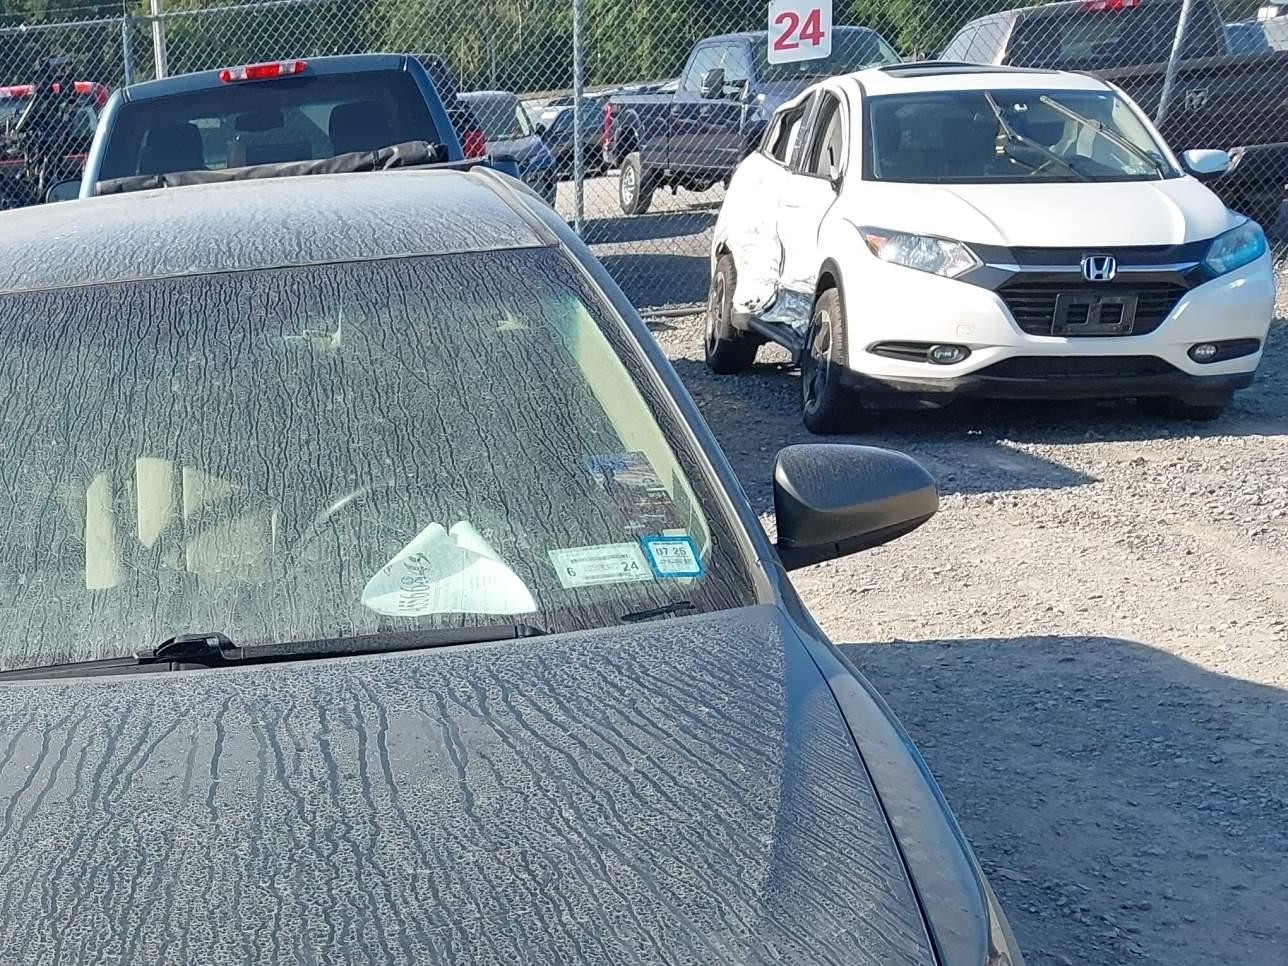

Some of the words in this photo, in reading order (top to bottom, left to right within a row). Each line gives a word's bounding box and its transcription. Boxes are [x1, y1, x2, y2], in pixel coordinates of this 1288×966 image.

[774, 8, 825, 51] 24
[566, 567, 577, 577] 6
[621, 561, 639, 572] 24
